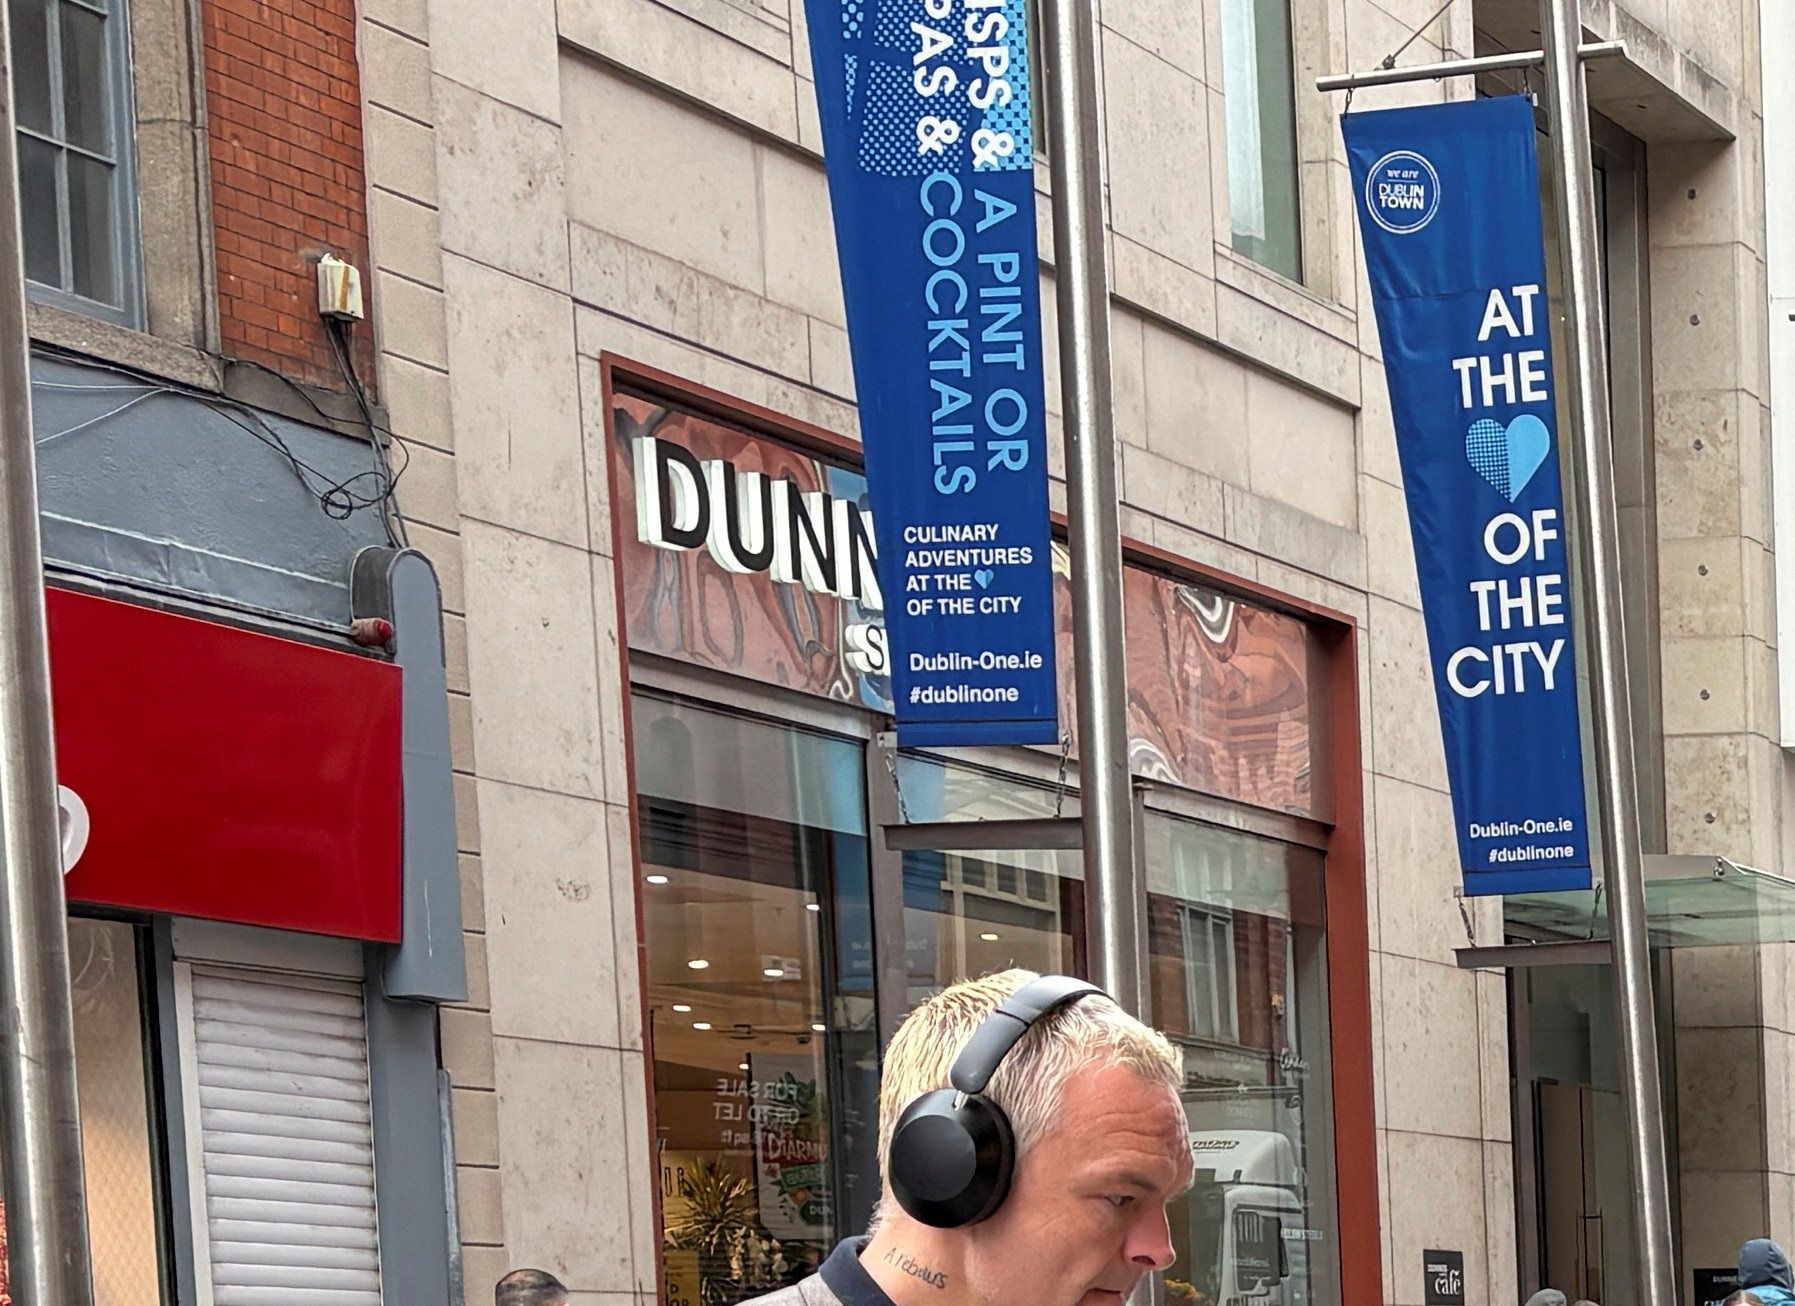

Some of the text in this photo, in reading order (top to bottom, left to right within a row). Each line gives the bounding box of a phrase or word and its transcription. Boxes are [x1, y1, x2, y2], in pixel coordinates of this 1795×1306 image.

[916, 115, 961, 155] &
[971, 128, 1014, 168] &
[1379, 183, 1425, 197] DUBLIN
[1380, 196, 1424, 209] TOWN
[974, 189, 1017, 233] A
[978, 252, 1025, 370] PINT
[1477, 284, 1539, 341] AT
[920, 171, 977, 494] COCKTAILS
[1452, 350, 1548, 408] THE
[985, 388, 1029, 472] OR
[904, 524, 999, 543] CULINARY
[1484, 508, 1558, 565] OF
[905, 547, 1033, 568] ADVENTURES
[906, 573, 971, 591] AT THE
[906, 596, 1022, 616] OF THE CITY
[1469, 574, 1565, 631] THE
[910, 651, 1043, 672] Dublin-One.ie
[1446, 638, 1566, 698] CITY
[910, 685, 1019, 704] #dublinone
[1470, 817, 1573, 838] Dublin-One.ie
[1489, 845, 1574, 862] #dublinone
